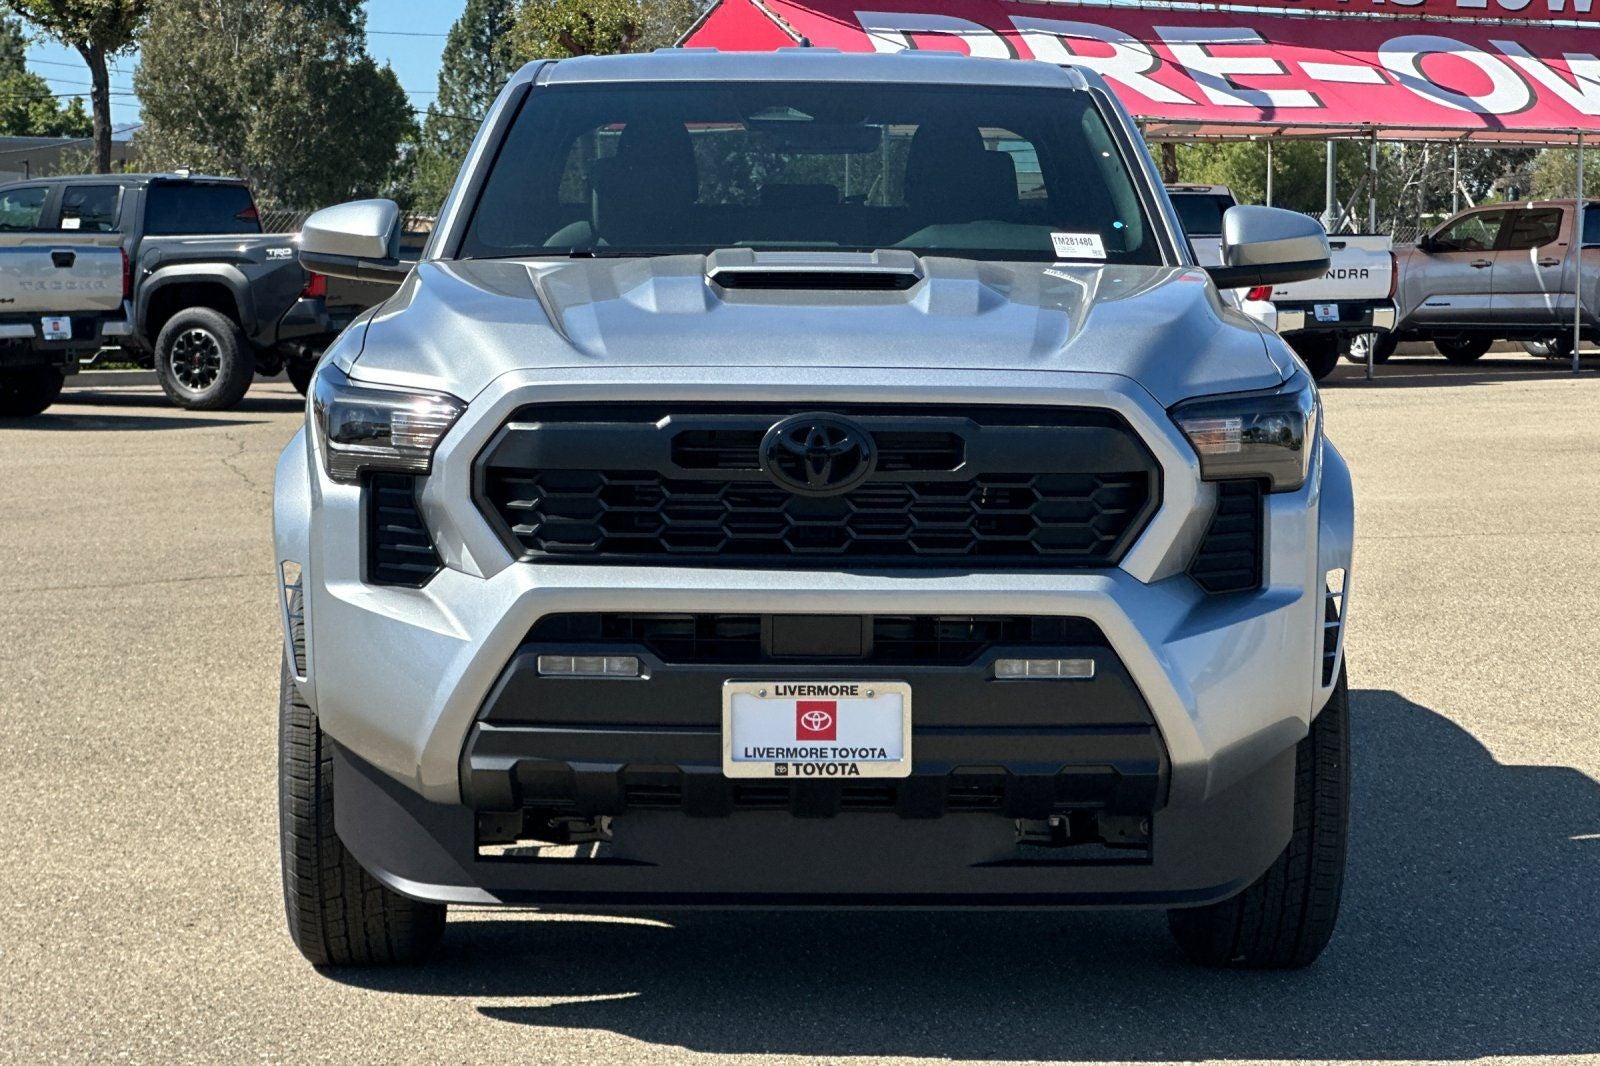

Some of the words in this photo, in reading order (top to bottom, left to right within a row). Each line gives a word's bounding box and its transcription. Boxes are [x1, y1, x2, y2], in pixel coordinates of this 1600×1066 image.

[266, 248, 292, 257] TRD
[1325, 269, 1369, 279] NDRA
[775, 685, 859, 696] LIVERMORE
[744, 747, 828, 759] LIVERMORE
[831, 747, 887, 759] TOYOTA
[792, 763, 860, 776] TOYOTA
